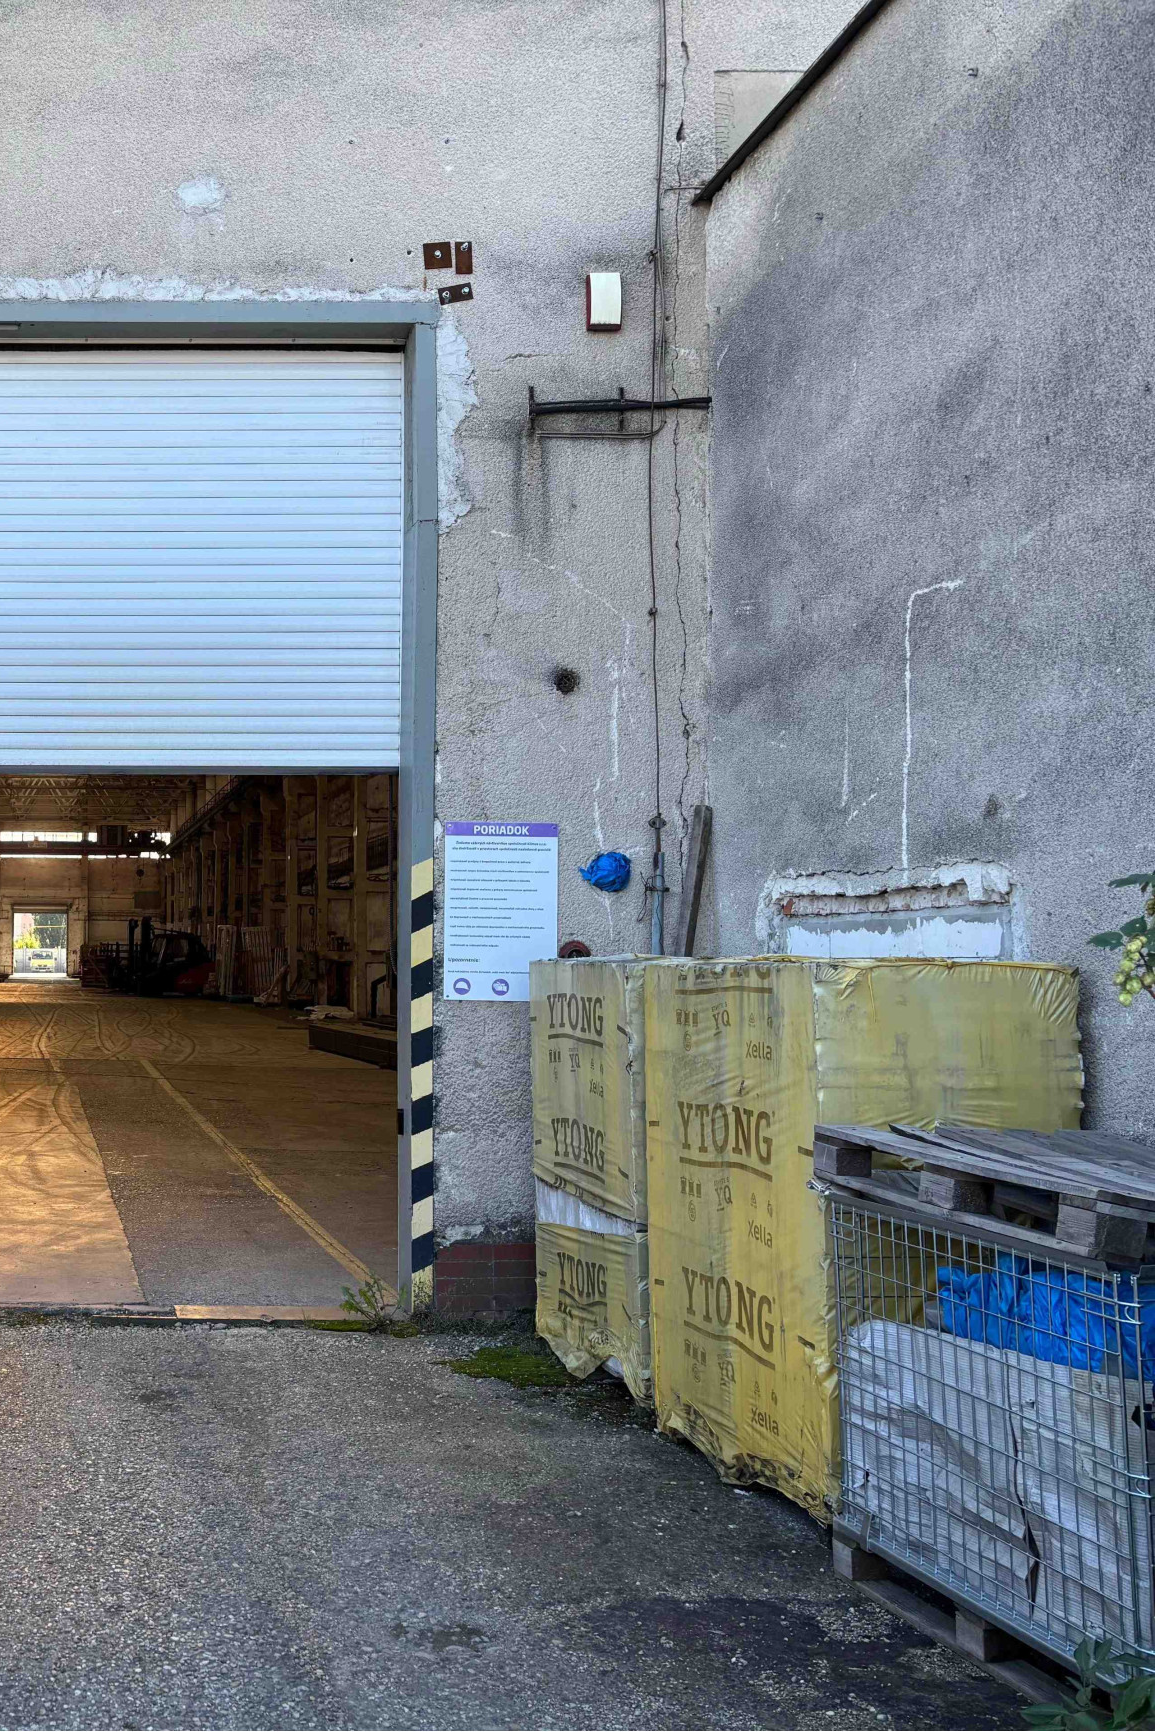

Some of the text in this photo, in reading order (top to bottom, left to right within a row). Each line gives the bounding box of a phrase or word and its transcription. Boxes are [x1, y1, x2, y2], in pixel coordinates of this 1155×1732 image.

[473, 825, 530, 836] PORIADOK
[546, 992, 604, 1037] YTONG
[745, 1040, 773, 1061] Xella
[550, 1117, 606, 1173] YTONG
[677, 1100, 774, 1166] YTONG
[748, 1219, 773, 1248] Xella
[557, 1252, 608, 1298] YTONG
[681, 1265, 776, 1354] YTONG
[750, 1406, 780, 1437] Xella
